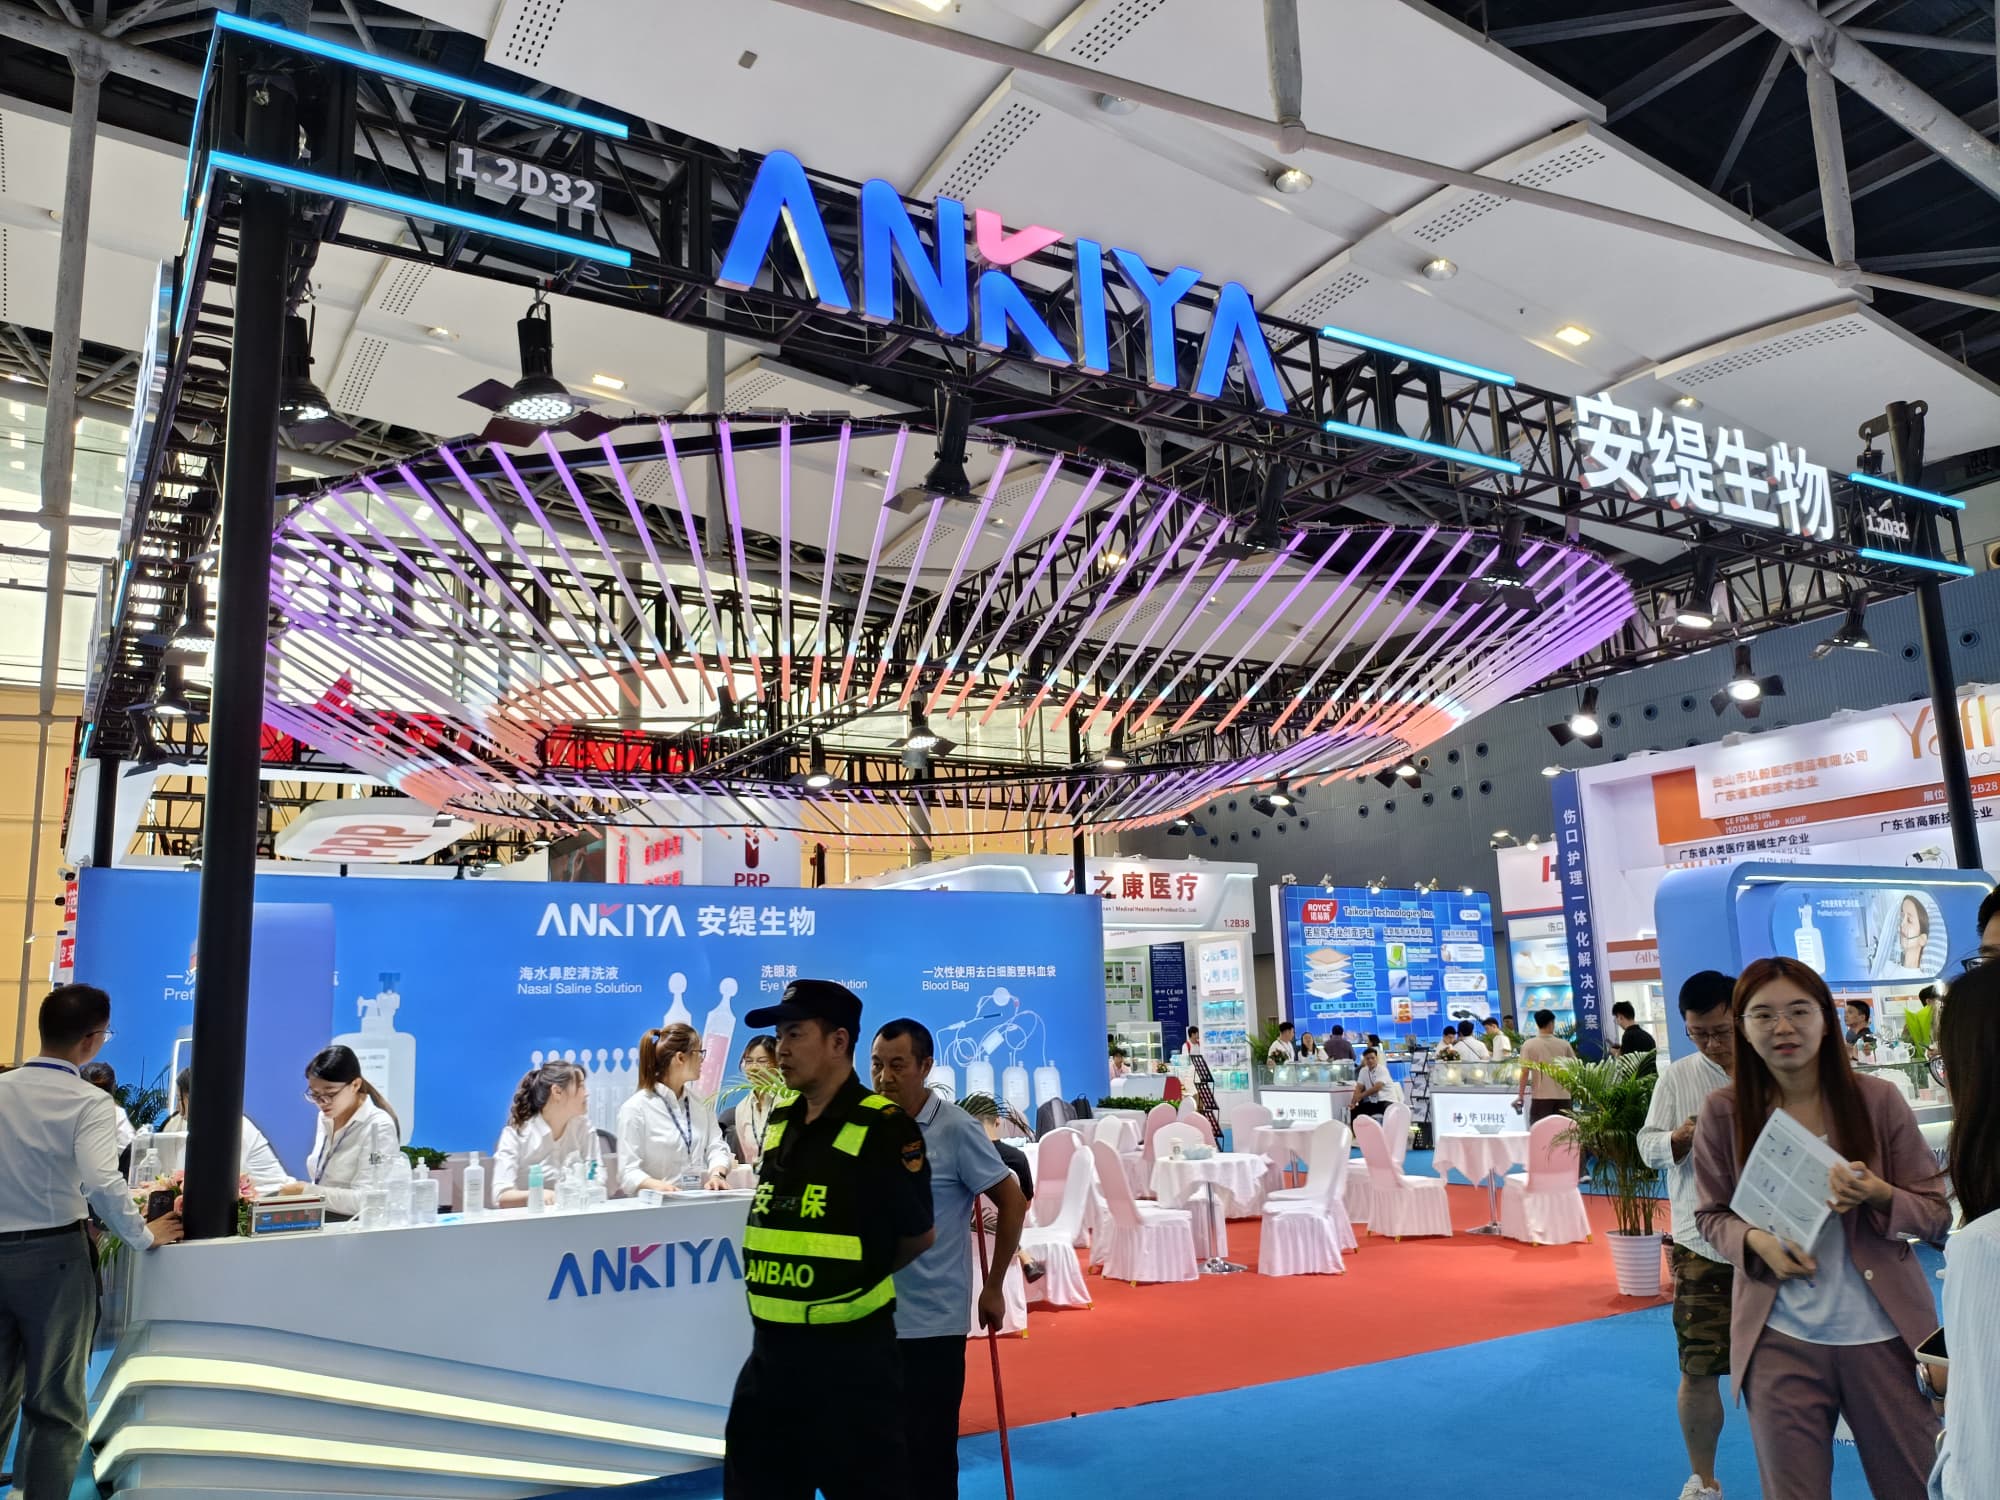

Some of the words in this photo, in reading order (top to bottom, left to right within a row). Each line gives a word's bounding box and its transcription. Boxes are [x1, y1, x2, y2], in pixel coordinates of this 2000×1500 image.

[456, 147, 597, 212] 1.2D32
[715, 150, 1288, 415] ANKIYA
[1574, 391, 1836, 541] 安缇生物
[1866, 514, 1910, 539] 1.2D32
[1679, 832, 1810, 860] 广东省A类医疗器械生产企业
[734, 872, 771, 888] PRP
[536, 902, 687, 937] ANKIYA
[697, 905, 816, 937] 安缇生物
[1343, 905, 1373, 916] Taikone
[1374, 907, 1422, 919] Technologies
[1563, 808, 1599, 1030] 伤口护理一体化解决方案
[1223, 919, 1250, 928] 1.2B38
[519, 966, 619, 981] 海水鼻腔清洗液
[761, 964, 798, 978] 洗眼液
[922, 965, 1057, 978] 一次性使用去白细胞塑料血袋
[517, 983, 552, 995] Nasal
[555, 982, 592, 995] Saline
[595, 981, 642, 994] Solution
[760, 980, 780, 992] Eye
[922, 980, 951, 991] Blood
[953, 980, 970, 992] Bag
[752, 1181, 828, 1219] 安保
[547, 1237, 744, 1301] ANKIYA
